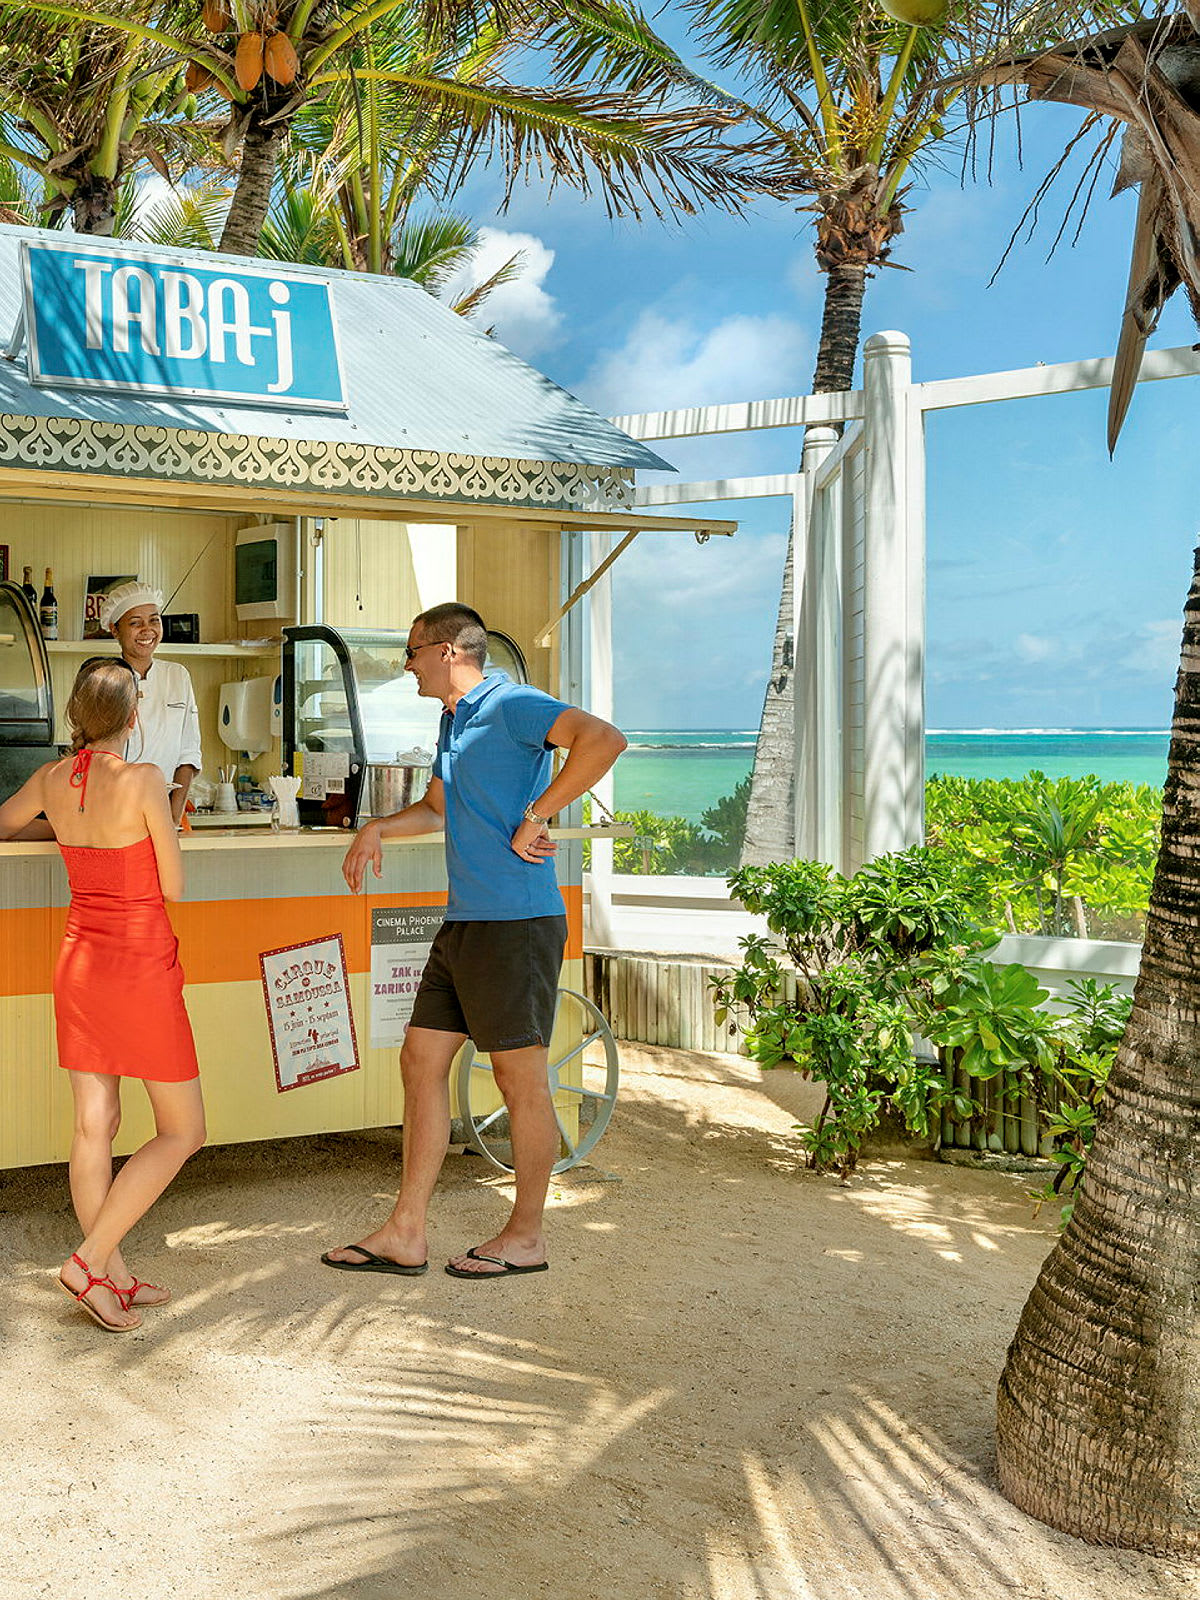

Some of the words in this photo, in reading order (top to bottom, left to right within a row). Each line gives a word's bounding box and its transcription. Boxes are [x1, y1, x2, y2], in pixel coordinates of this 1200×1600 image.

[73, 259, 294, 393] TABA-j
[377, 917, 407, 928] CINEMA
[409, 916, 444, 926] PHOENIX
[396, 927, 425, 936] PALACE
[275, 960, 336, 991] CIRQUE
[391, 966, 412, 979] ZAK
[276, 981, 343, 1009] SAMOUSSA
[374, 982, 412, 995] ZARIKO
